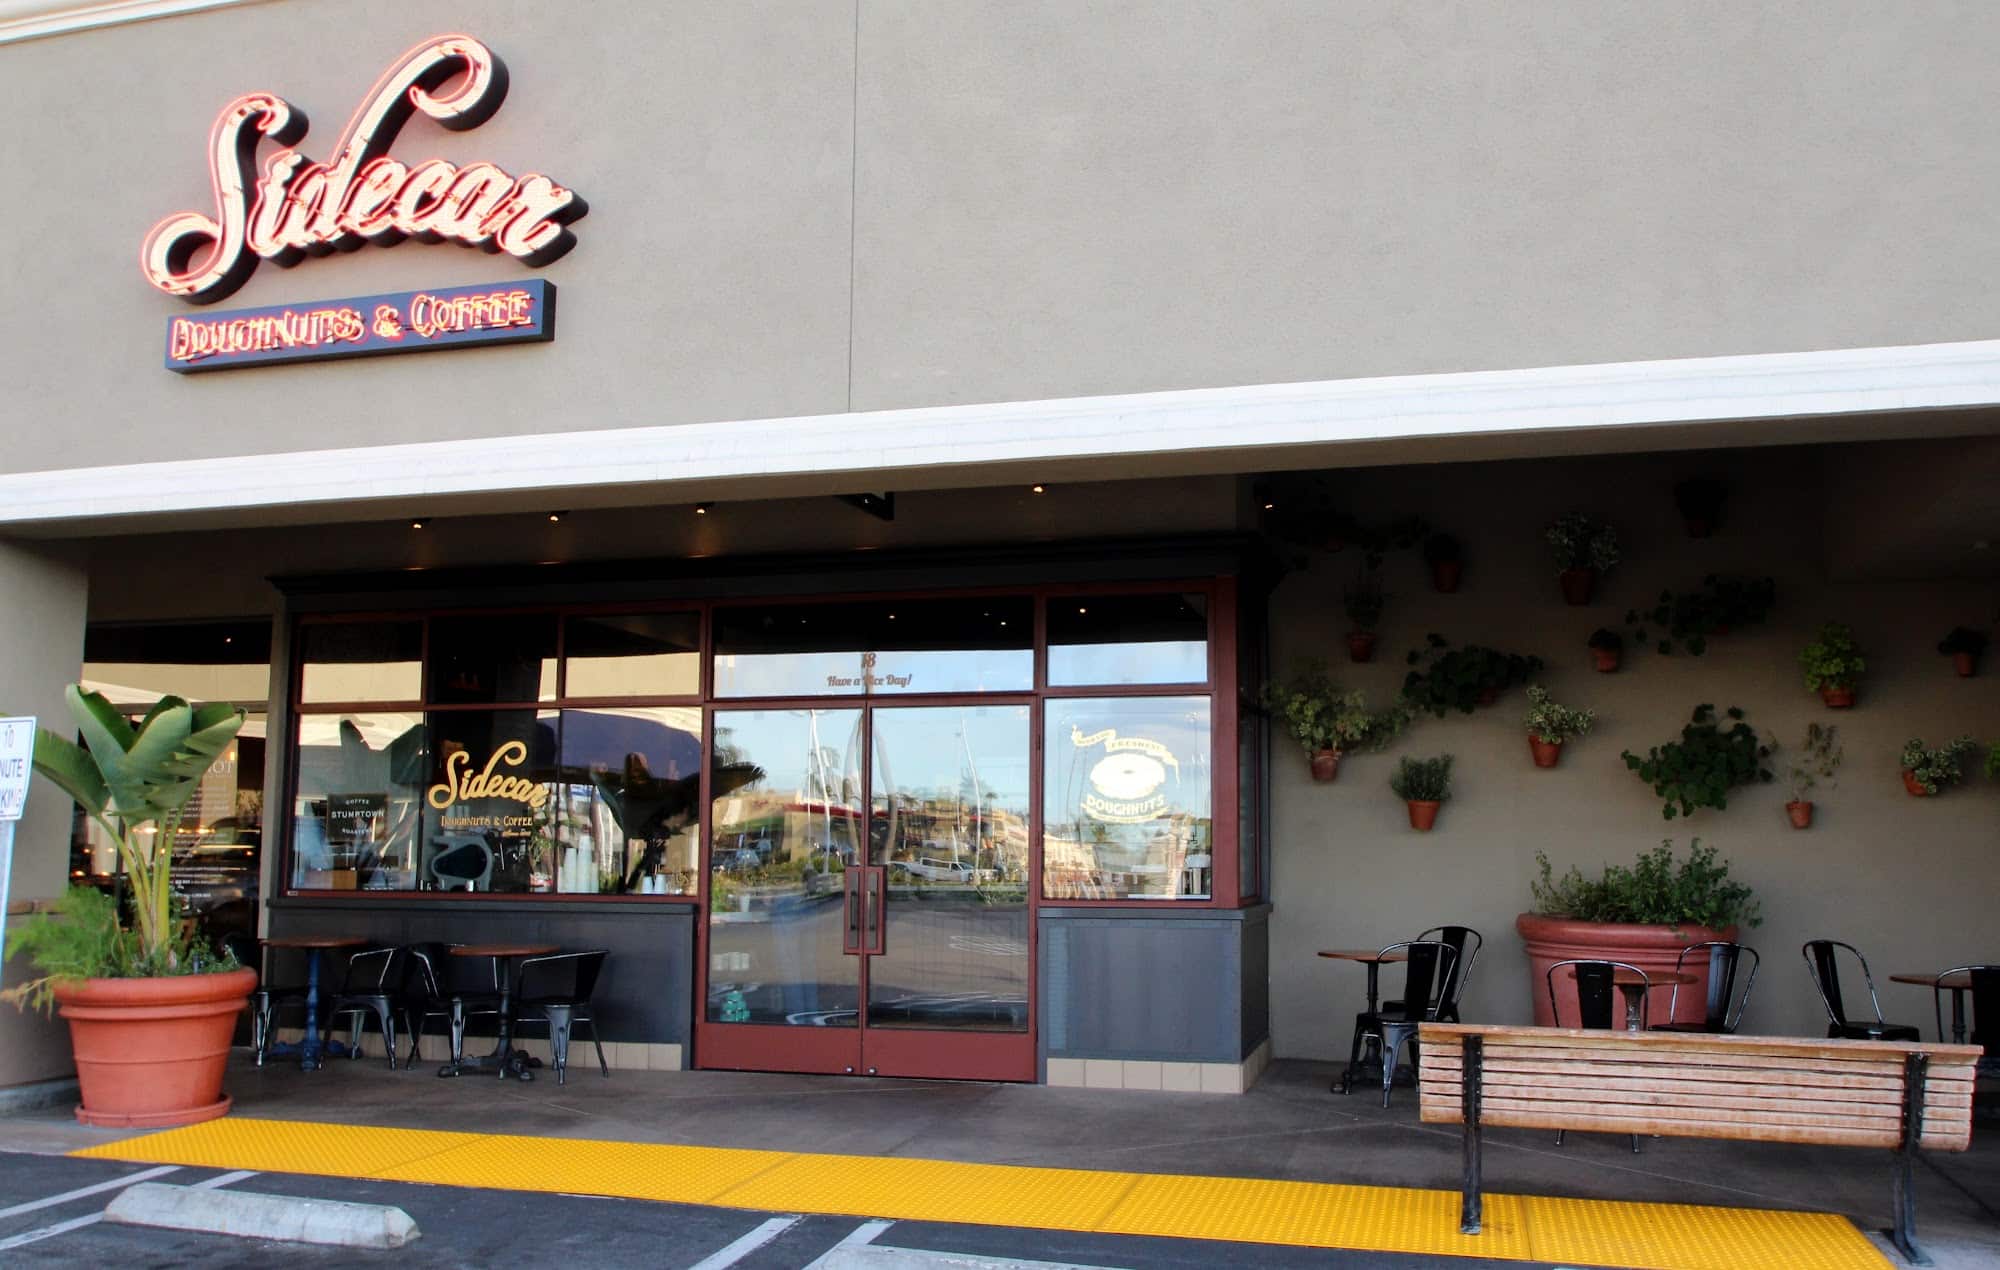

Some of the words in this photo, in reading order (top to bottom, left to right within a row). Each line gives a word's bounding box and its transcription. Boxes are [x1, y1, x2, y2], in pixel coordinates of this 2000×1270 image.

[141, 33, 586, 300] Sidecar
[171, 308, 365, 361] DOUGHNUTS
[372, 305, 402, 338] &
[410, 292, 533, 338] COFFEE
[827, 675, 852, 687] Have
[853, 678, 861, 686] a
[886, 673, 913, 688] Day!
[428, 740, 549, 809] Sidecar
[331, 809, 385, 819] STUMPTOWN
[1087, 794, 1165, 815] DOUGHNUTS
[503, 815, 533, 826] COFFEE
